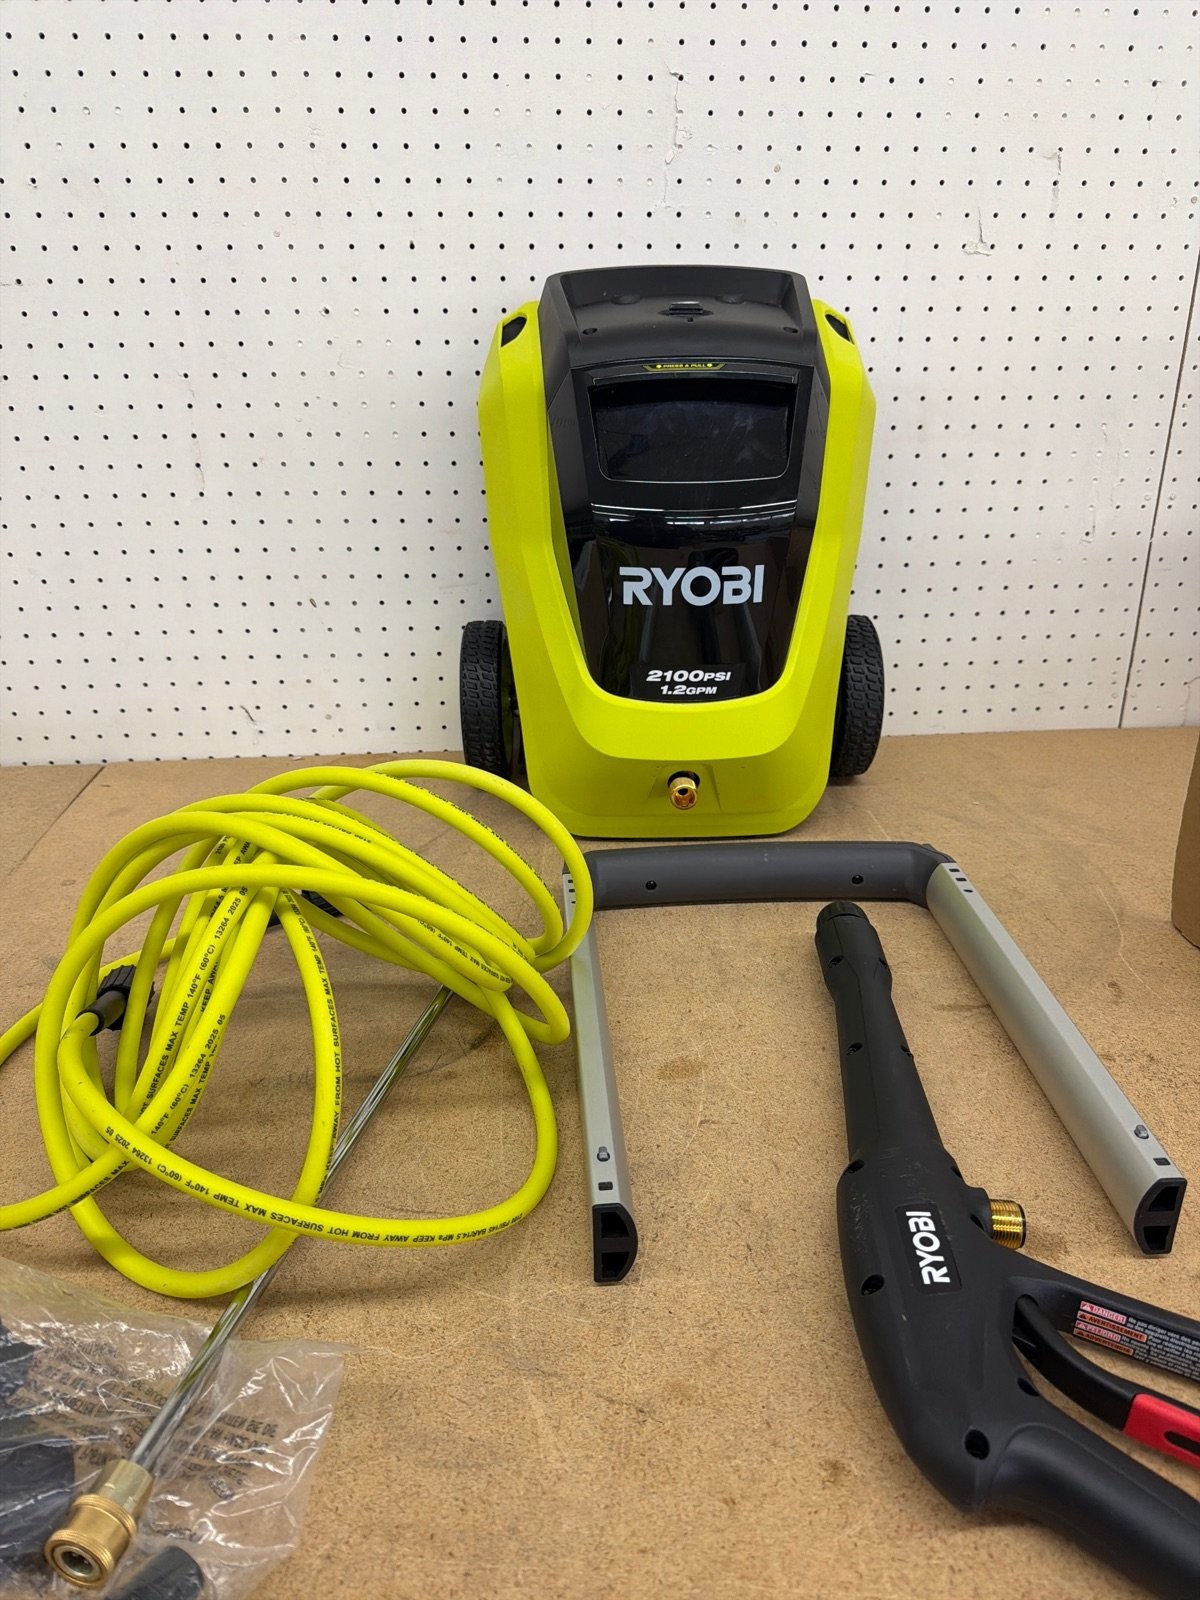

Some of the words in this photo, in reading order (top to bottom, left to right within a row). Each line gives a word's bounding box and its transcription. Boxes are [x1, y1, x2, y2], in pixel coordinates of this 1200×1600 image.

[619, 564, 765, 607] RYOBI
[646, 670, 731, 682] 2100PSI
[660, 685, 717, 695] 1.2GPM
[147, 1054, 169, 1100] SURFACES
[165, 1031, 179, 1052] MAX
[175, 1001, 189, 1028] TEMP
[187, 973, 202, 999] 140°F
[199, 944, 216, 971] (60°C)
[214, 917, 231, 940] 13264
[228, 897, 242, 916] 2025
[239, 886, 249, 896] 05
[321, 977, 333, 997] MAX
[326, 998, 340, 1048] SURFACES
[333, 1052, 342, 1074] HOT
[151, 1112, 169, 1136] 140°F
[169, 1083, 190, 1111] (60°C)
[189, 1053, 207, 1080] 13264
[204, 1028, 219, 1051] 2025
[216, 1013, 227, 1026] 05
[190, 1087, 202, 1106] MAX
[198, 1061, 211, 1085] TEMP
[334, 1076, 342, 1106] FROM
[104, 1125, 115, 1137] 05
[114, 1134, 131, 1150] 2025
[131, 1146, 153, 1166] 13264
[156, 1163, 183, 1182] (60°C)
[184, 1179, 211, 1196] 140°F
[213, 1193, 240, 1209] TEMP
[243, 1202, 268, 1217] MAX
[270, 1211, 324, 1232] SURFACES
[327, 1225, 350, 1237] HOT
[351, 1230, 380, 1241] FROM
[383, 1233, 410, 1243] AWAY
[412, 1234, 436, 1243] KEEP
[438, 1233, 455, 1243] MPa
[905, 1211, 951, 1285] RYOBI
[1093, 1304, 1126, 1323] DANGER
[1088, 1315, 1144, 1341] AVERTISSEMENT
